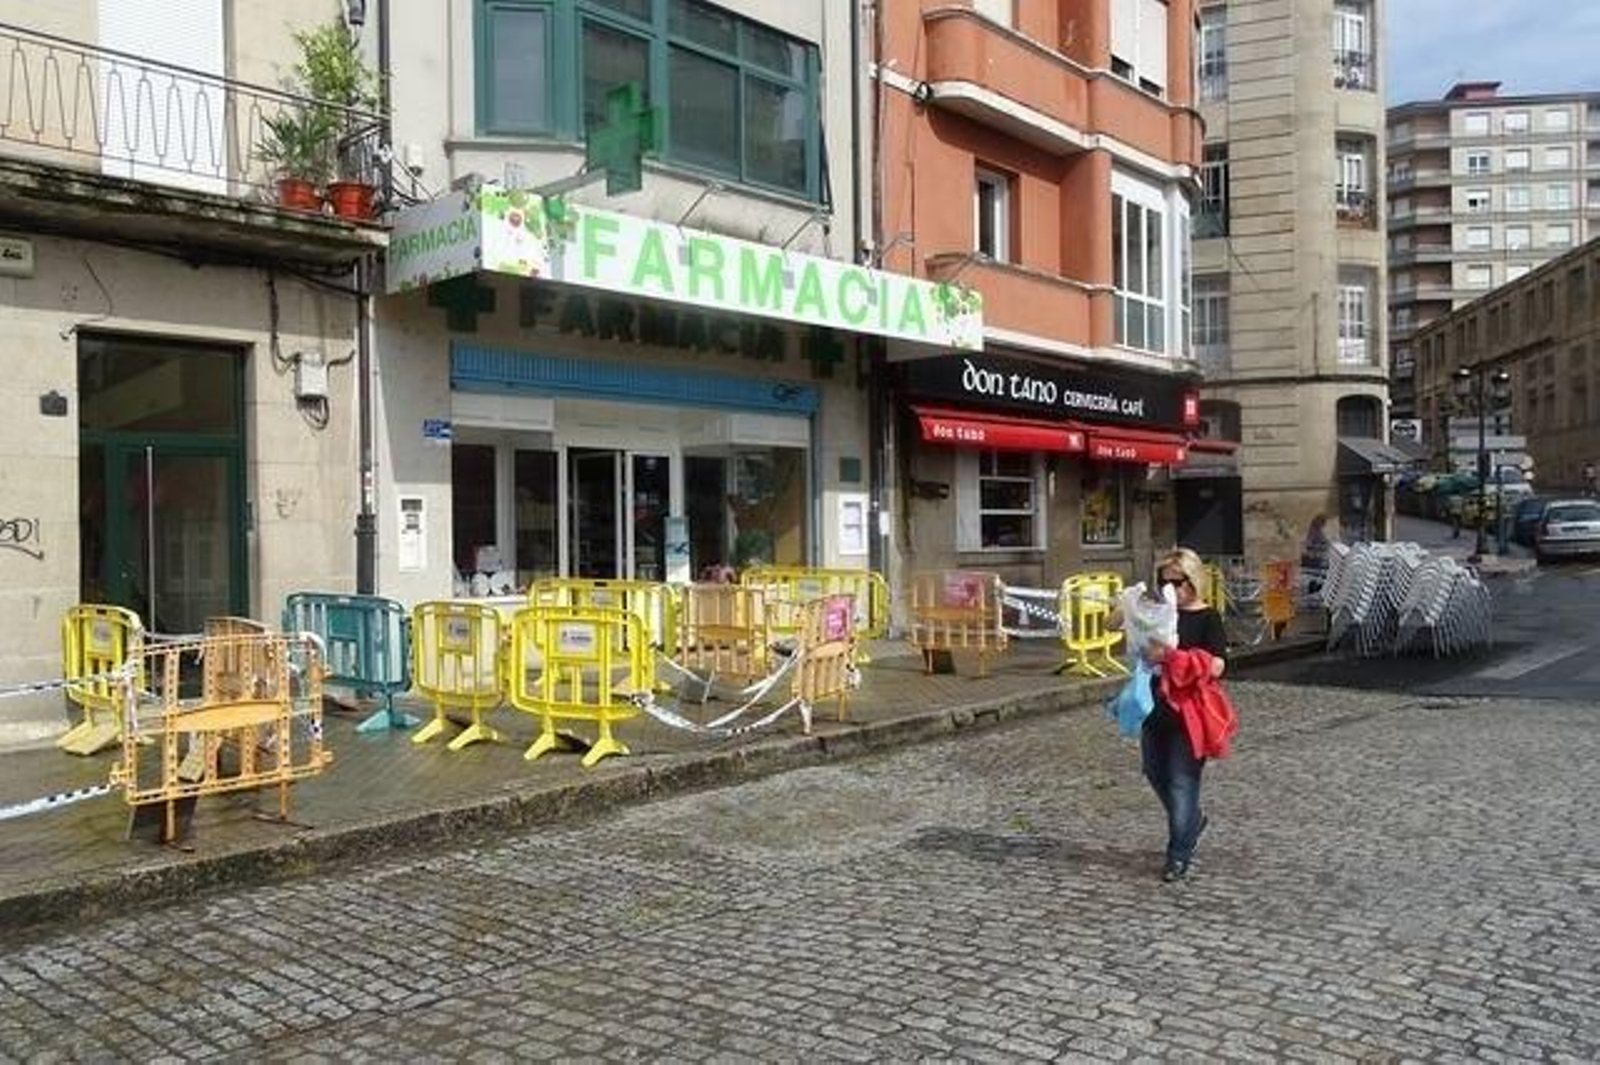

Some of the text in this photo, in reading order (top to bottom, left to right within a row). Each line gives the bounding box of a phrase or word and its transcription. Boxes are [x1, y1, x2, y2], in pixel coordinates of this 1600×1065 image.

[389, 216, 478, 262] FARMACIA
[580, 212, 928, 335] FARMACIA
[519, 283, 785, 362] FARMACIA
[963, 359, 1005, 396] don
